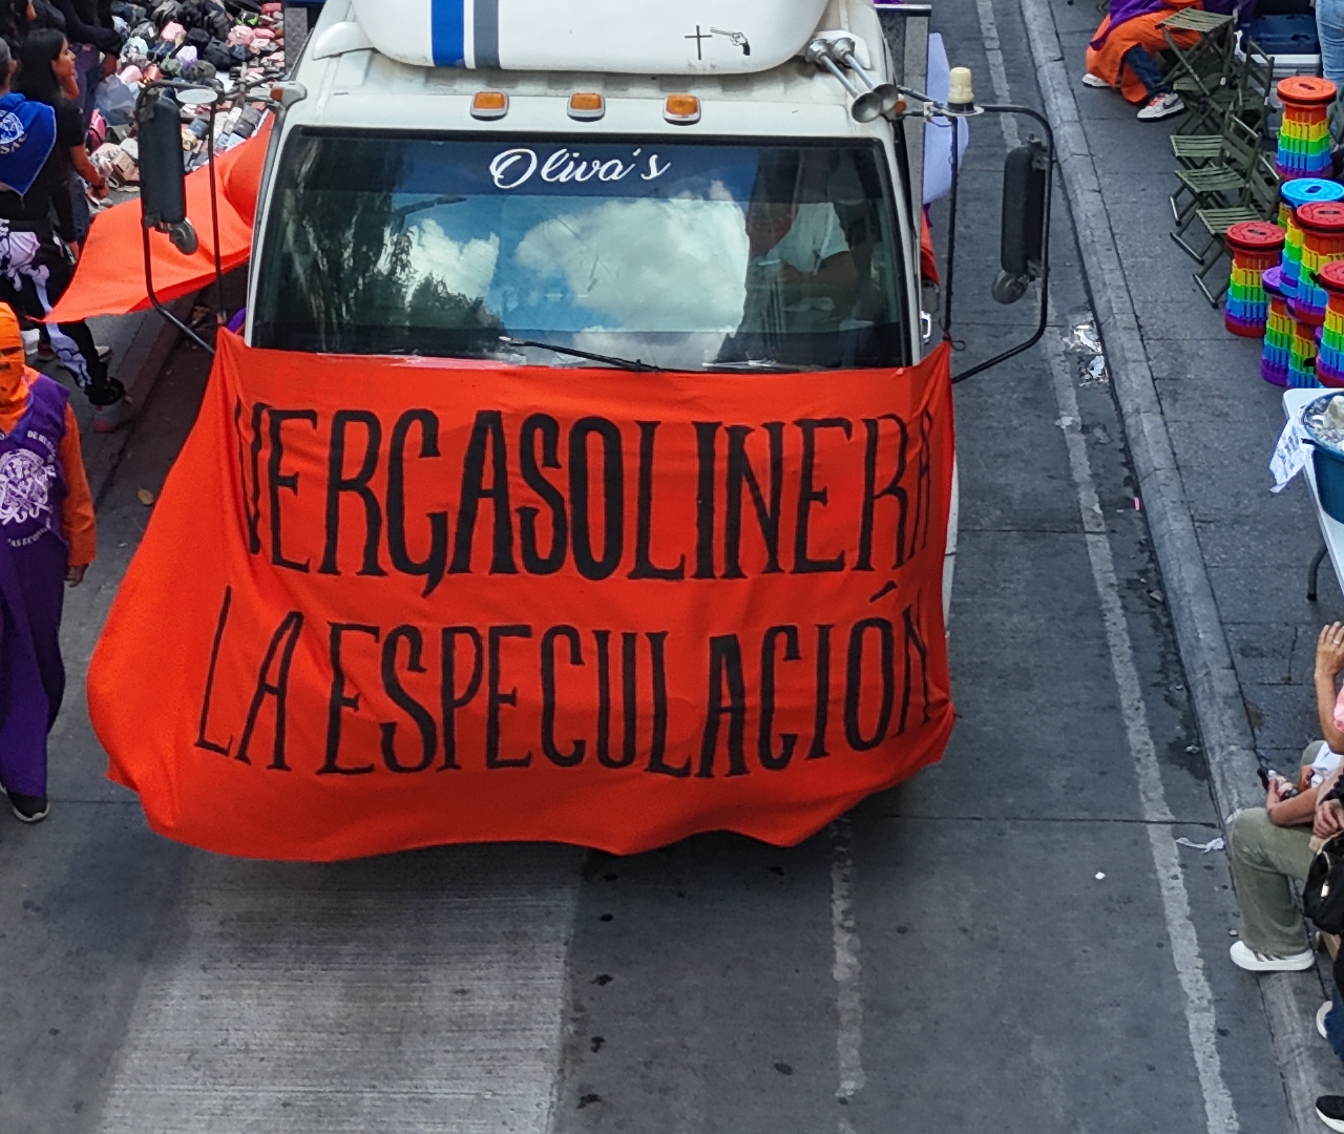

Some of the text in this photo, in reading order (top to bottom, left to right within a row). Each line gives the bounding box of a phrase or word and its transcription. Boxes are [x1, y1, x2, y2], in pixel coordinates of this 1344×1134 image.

[489, 147, 672, 190] Oliva's
[194, 580, 929, 780] LA ESPECULACIÓN
